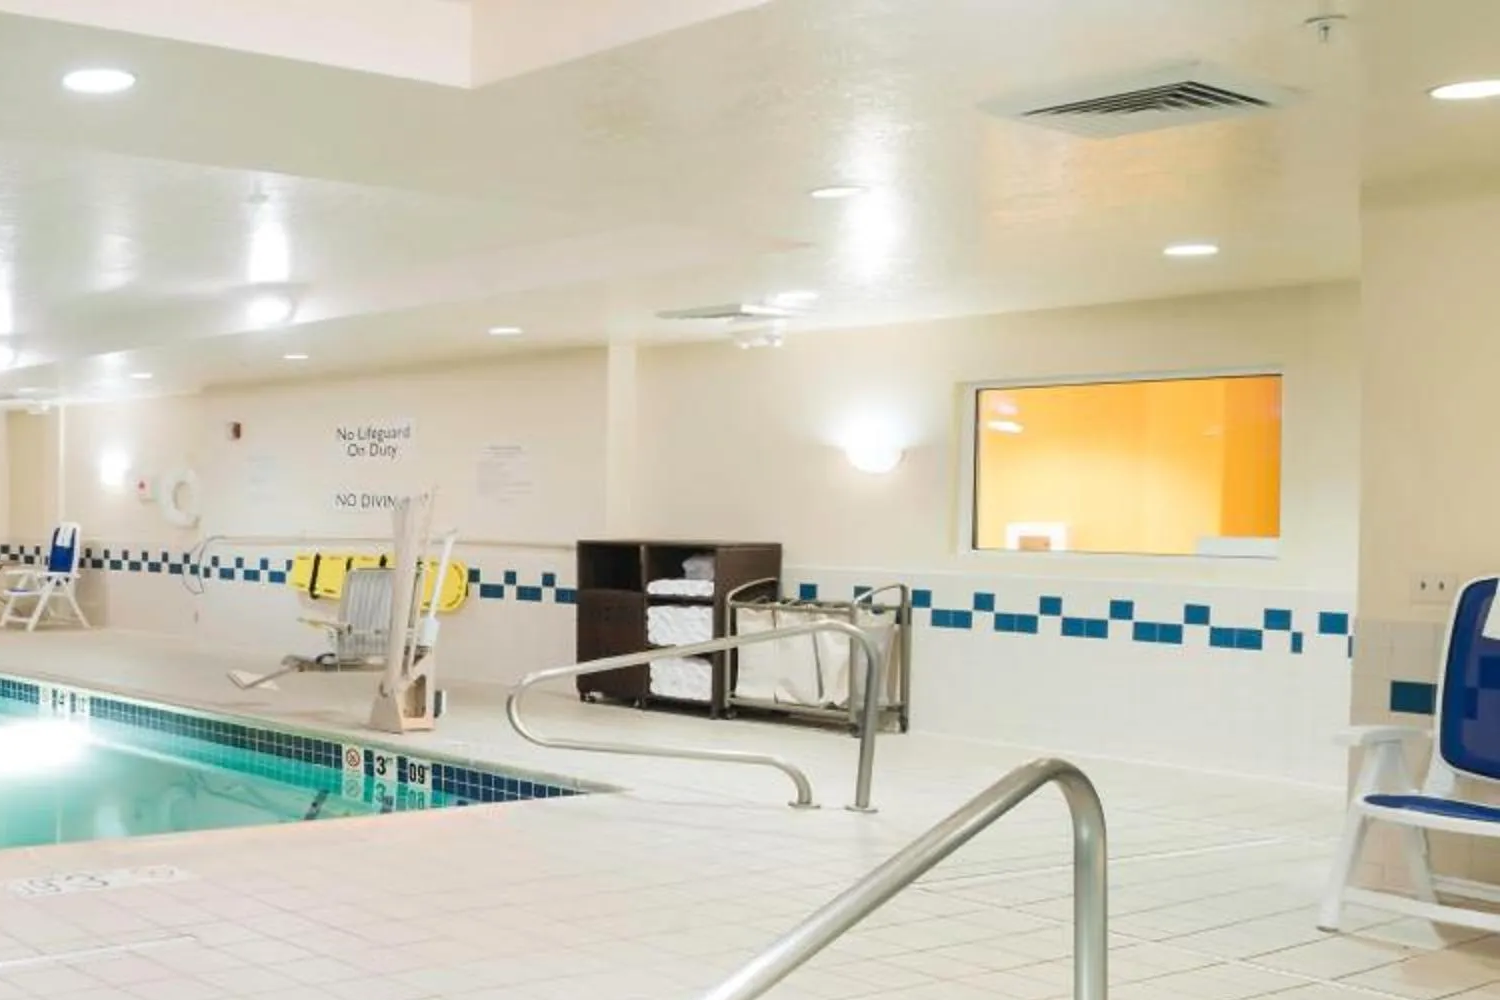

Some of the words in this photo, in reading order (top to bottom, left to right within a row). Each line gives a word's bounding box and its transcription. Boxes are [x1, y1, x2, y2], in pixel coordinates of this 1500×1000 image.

[336, 427, 355, 440] No
[357, 425, 411, 443] Lifeguard
[347, 443, 365, 456] On
[369, 443, 397, 459] Duty
[335, 493, 357, 507] NO
[361, 494, 399, 508] DIVIN
[376, 756, 387, 775] 3
